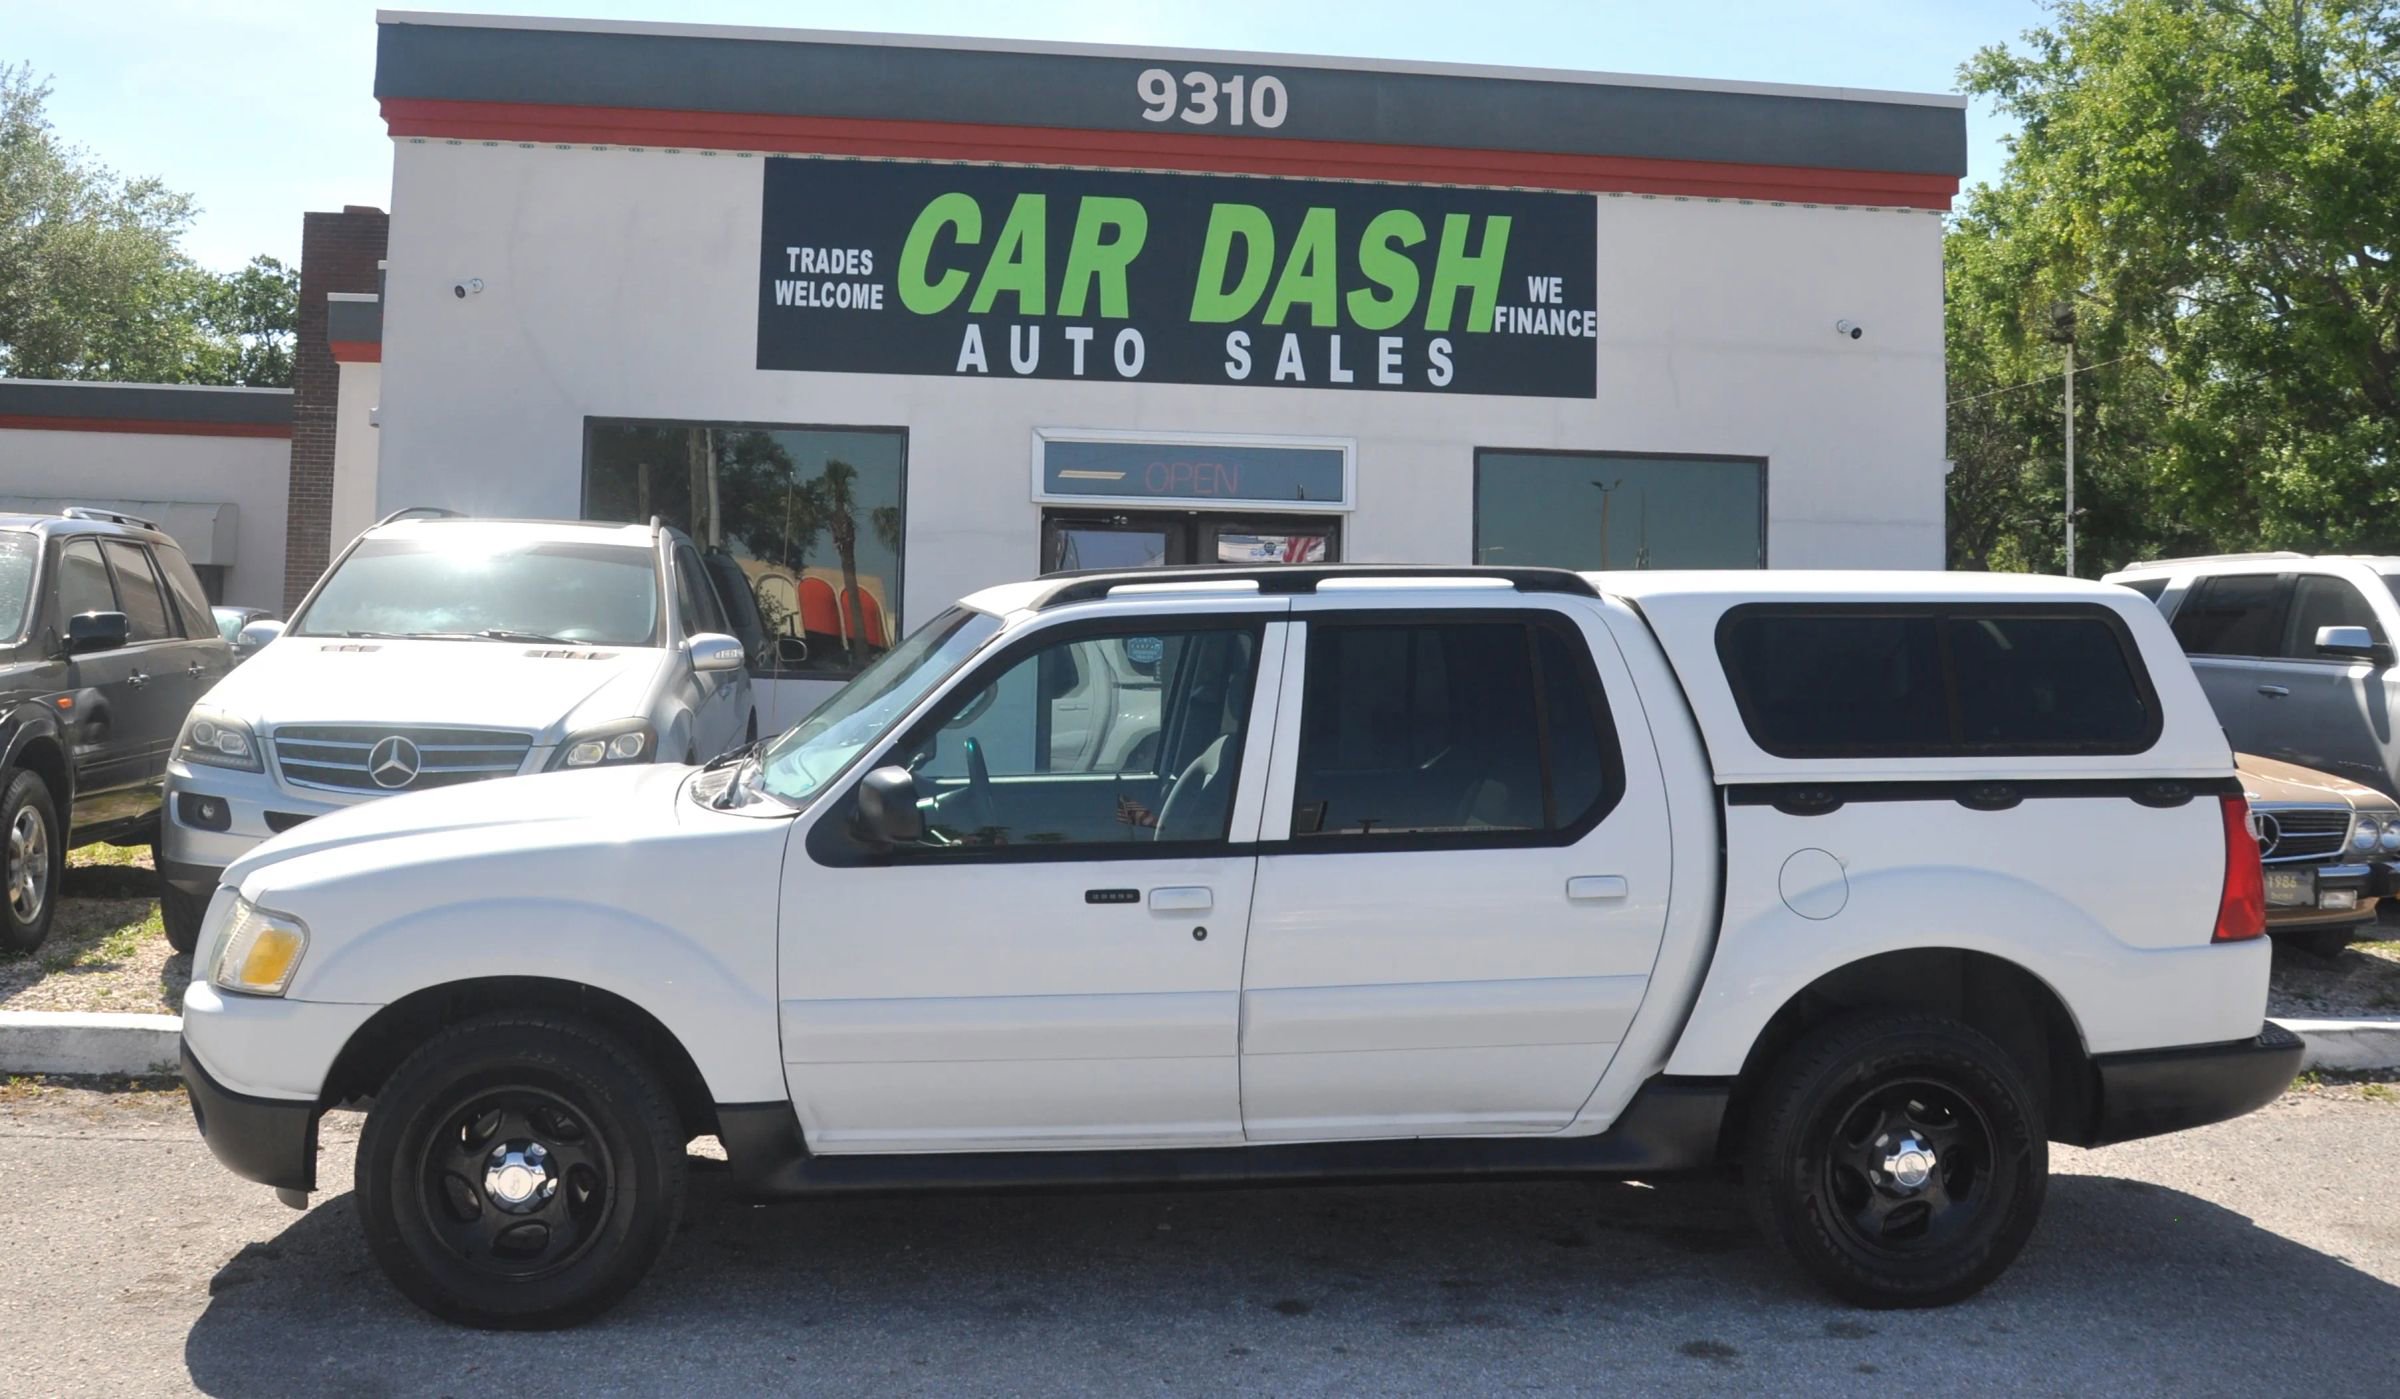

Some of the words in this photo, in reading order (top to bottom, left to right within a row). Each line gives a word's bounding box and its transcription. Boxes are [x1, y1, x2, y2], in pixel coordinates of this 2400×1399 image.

[1136, 68, 1288, 129] 9310
[786, 247, 873, 276] TRADES
[898, 193, 1147, 318] CAR
[1190, 203, 1511, 333] DASH
[775, 279, 884, 310] WELCOME
[1527, 275, 1563, 304] WE
[1494, 306, 1597, 338] FINANCE
[956, 323, 1145, 378] AUTO
[1224, 330, 1454, 387] SALES
[1144, 461, 1239, 496] OPEN
[2268, 875, 2297, 888] 1986
